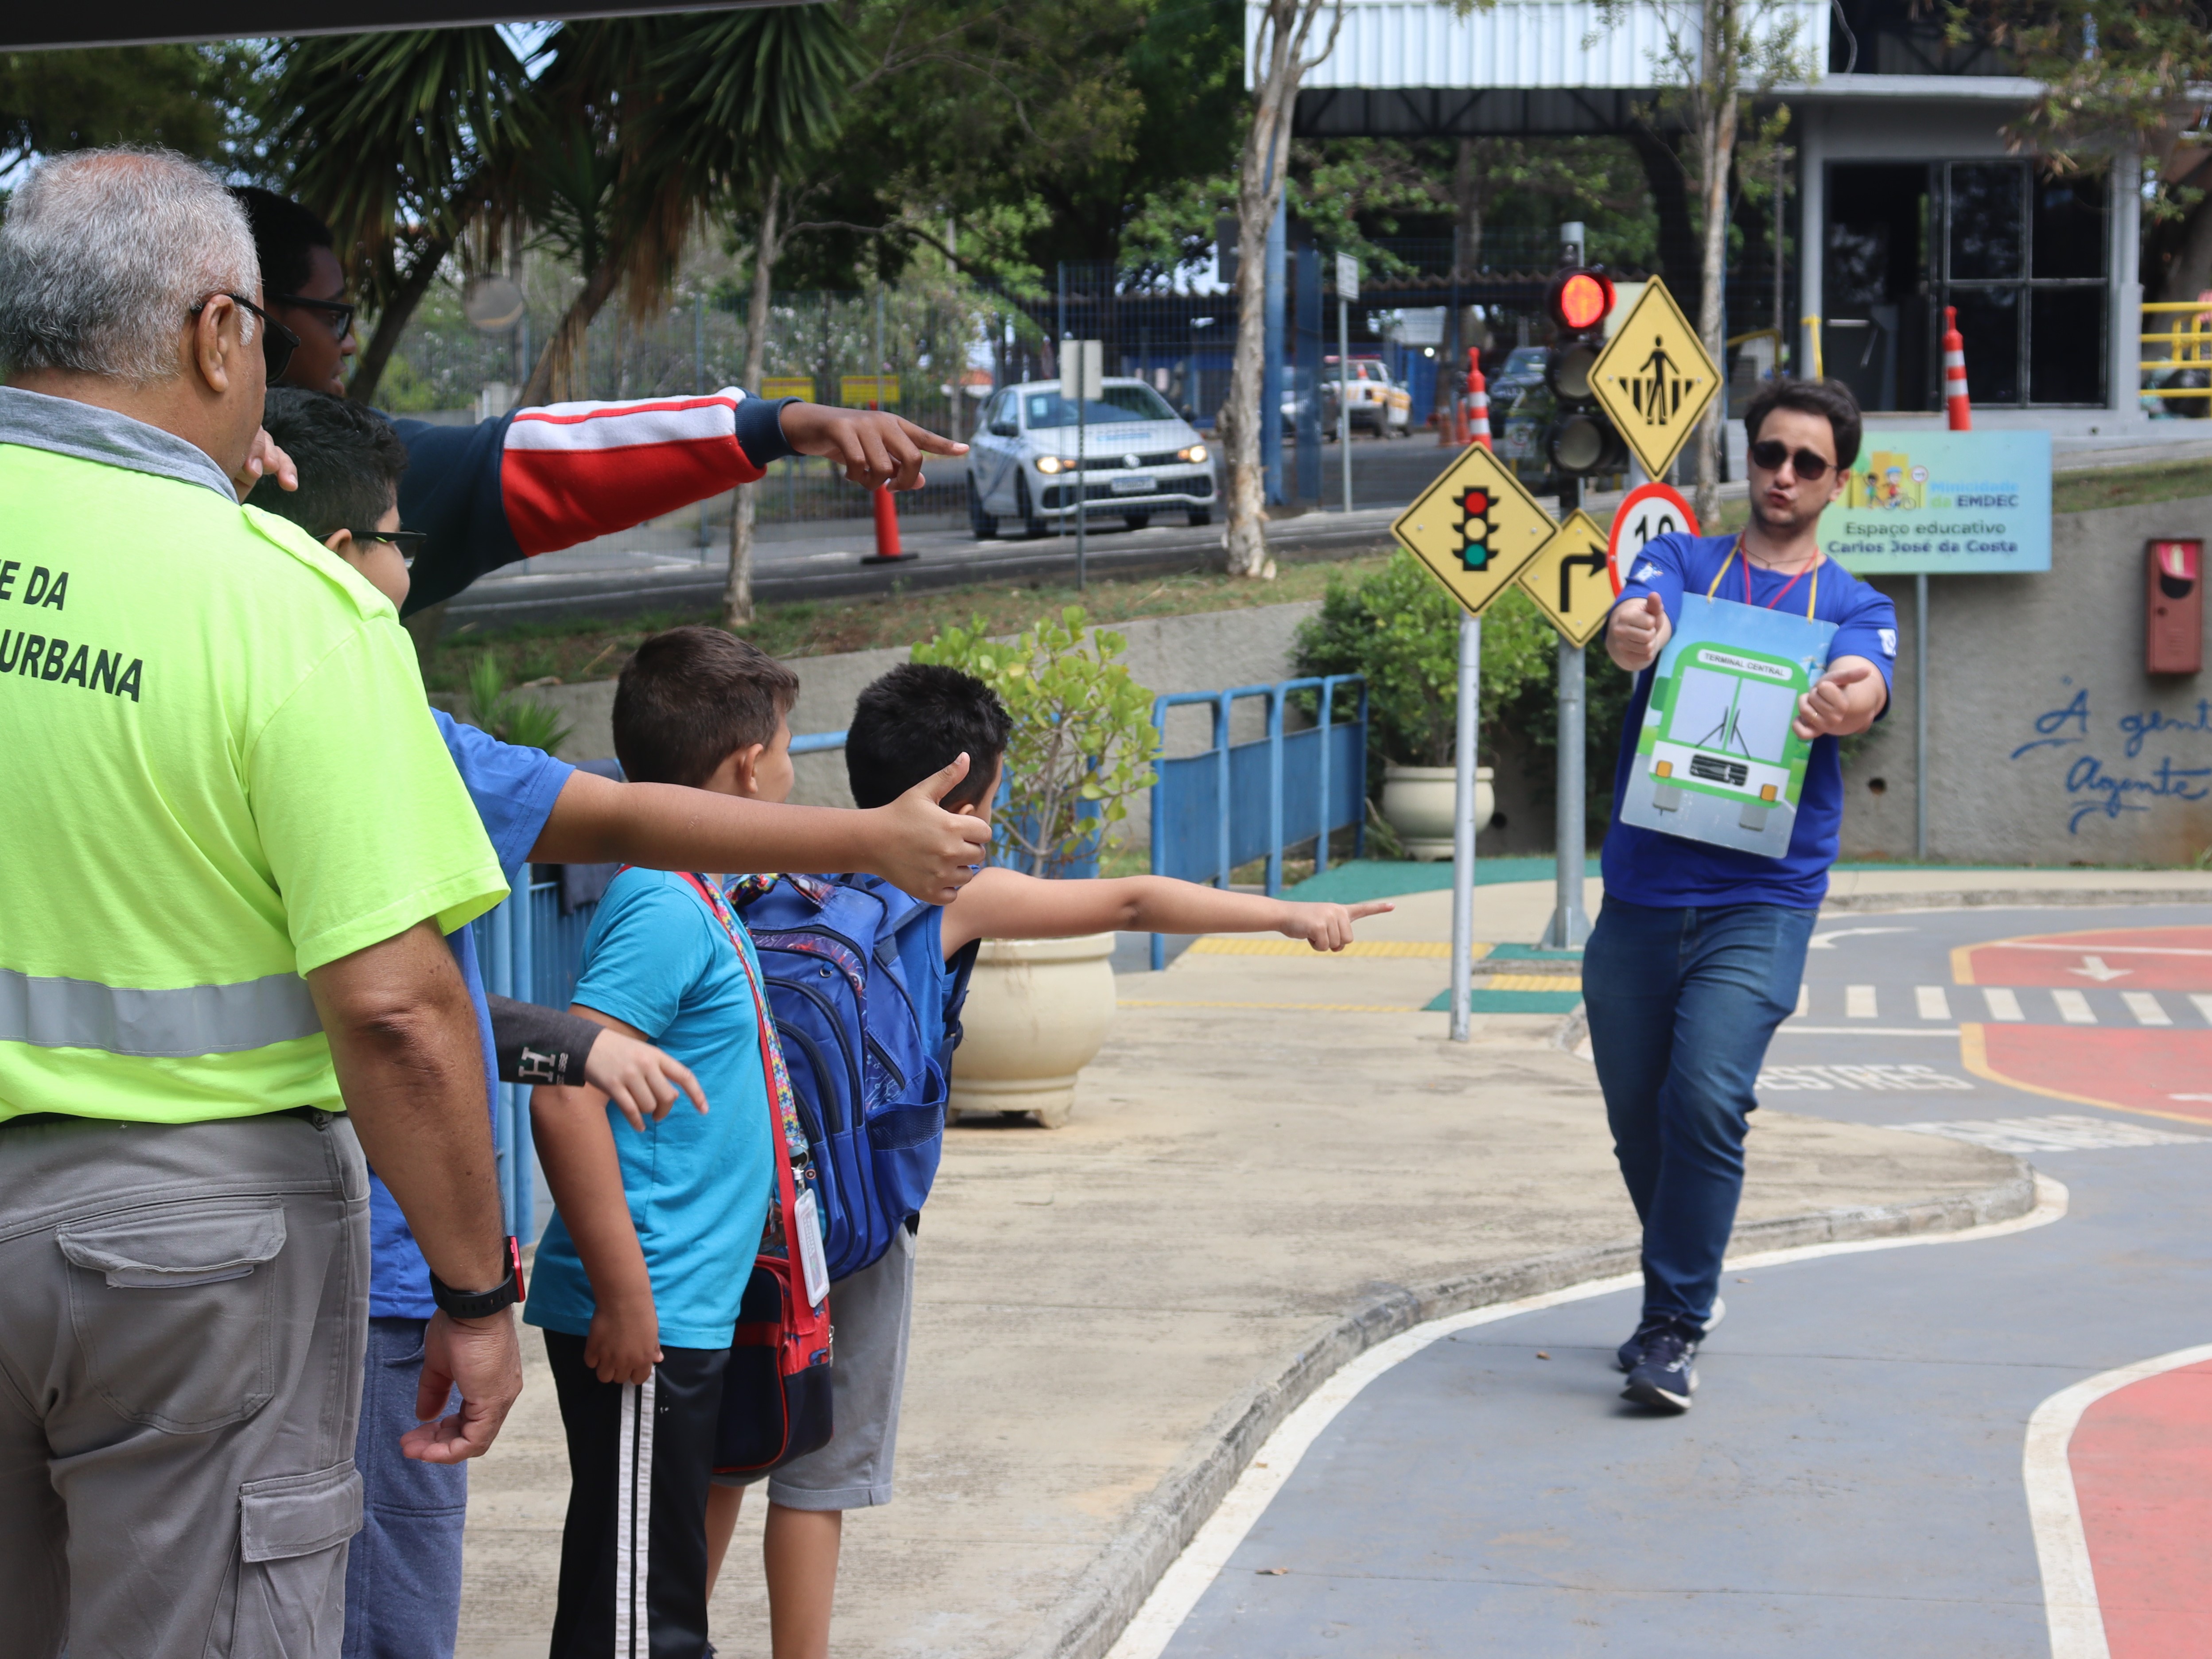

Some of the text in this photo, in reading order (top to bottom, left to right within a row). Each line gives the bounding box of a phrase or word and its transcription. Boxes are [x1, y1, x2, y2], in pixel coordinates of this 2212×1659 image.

[1931, 481, 2018, 492] Minicidade
[1931, 494, 2019, 507] da EMDEC
[1846, 520, 2006, 537] Espaço educativo
[1827, 539, 2018, 553] Carlos José da Costa
[0, 559, 69, 611] E DA
[0, 629, 143, 703] URBANA
[1705, 653, 1785, 676] TERMINAL CENTRAL
[1753, 1064, 1976, 1090] ESTRES
